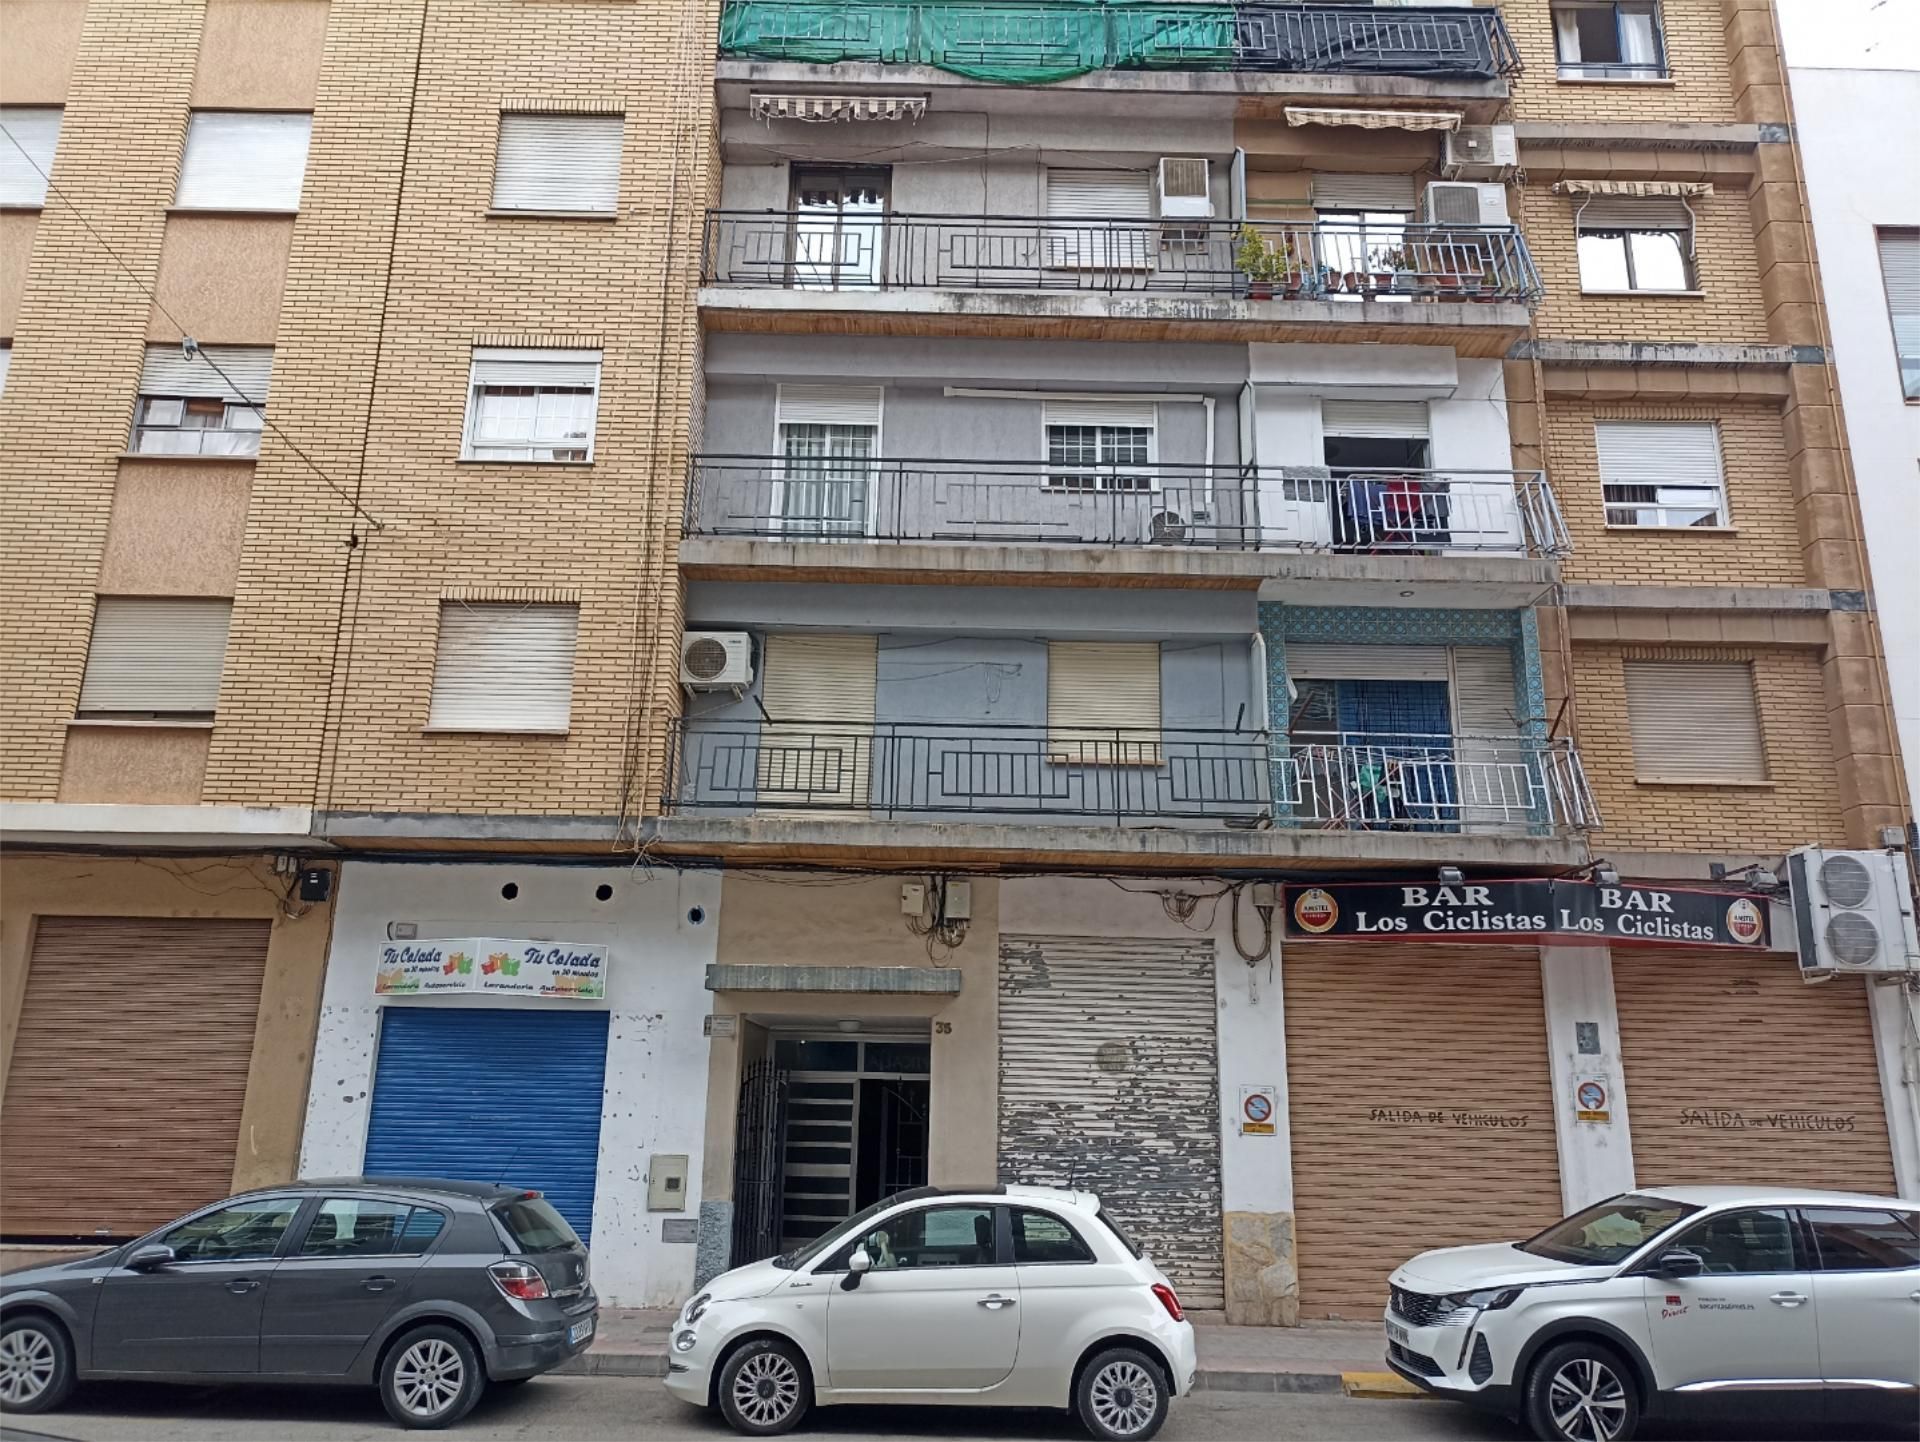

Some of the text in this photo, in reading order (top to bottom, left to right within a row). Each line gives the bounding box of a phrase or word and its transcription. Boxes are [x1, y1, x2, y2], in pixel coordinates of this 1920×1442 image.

[1402, 886, 1494, 907] BAR
[1600, 888, 1674, 912] BAR
[1356, 910, 1547, 931] Los Ciclistas
[1560, 908, 1714, 940] Los Ciclistas
[384, 946, 442, 964] Tu Colada
[524, 947, 601, 968] Tu Colada
[935, 1021, 952, 1035] 35
[1368, 1109, 1529, 1128] SALIDA DE VEHICULOS
[1679, 1108, 1745, 1127] SALIDA
[1766, 1114, 1856, 1132] VEHICULOS
